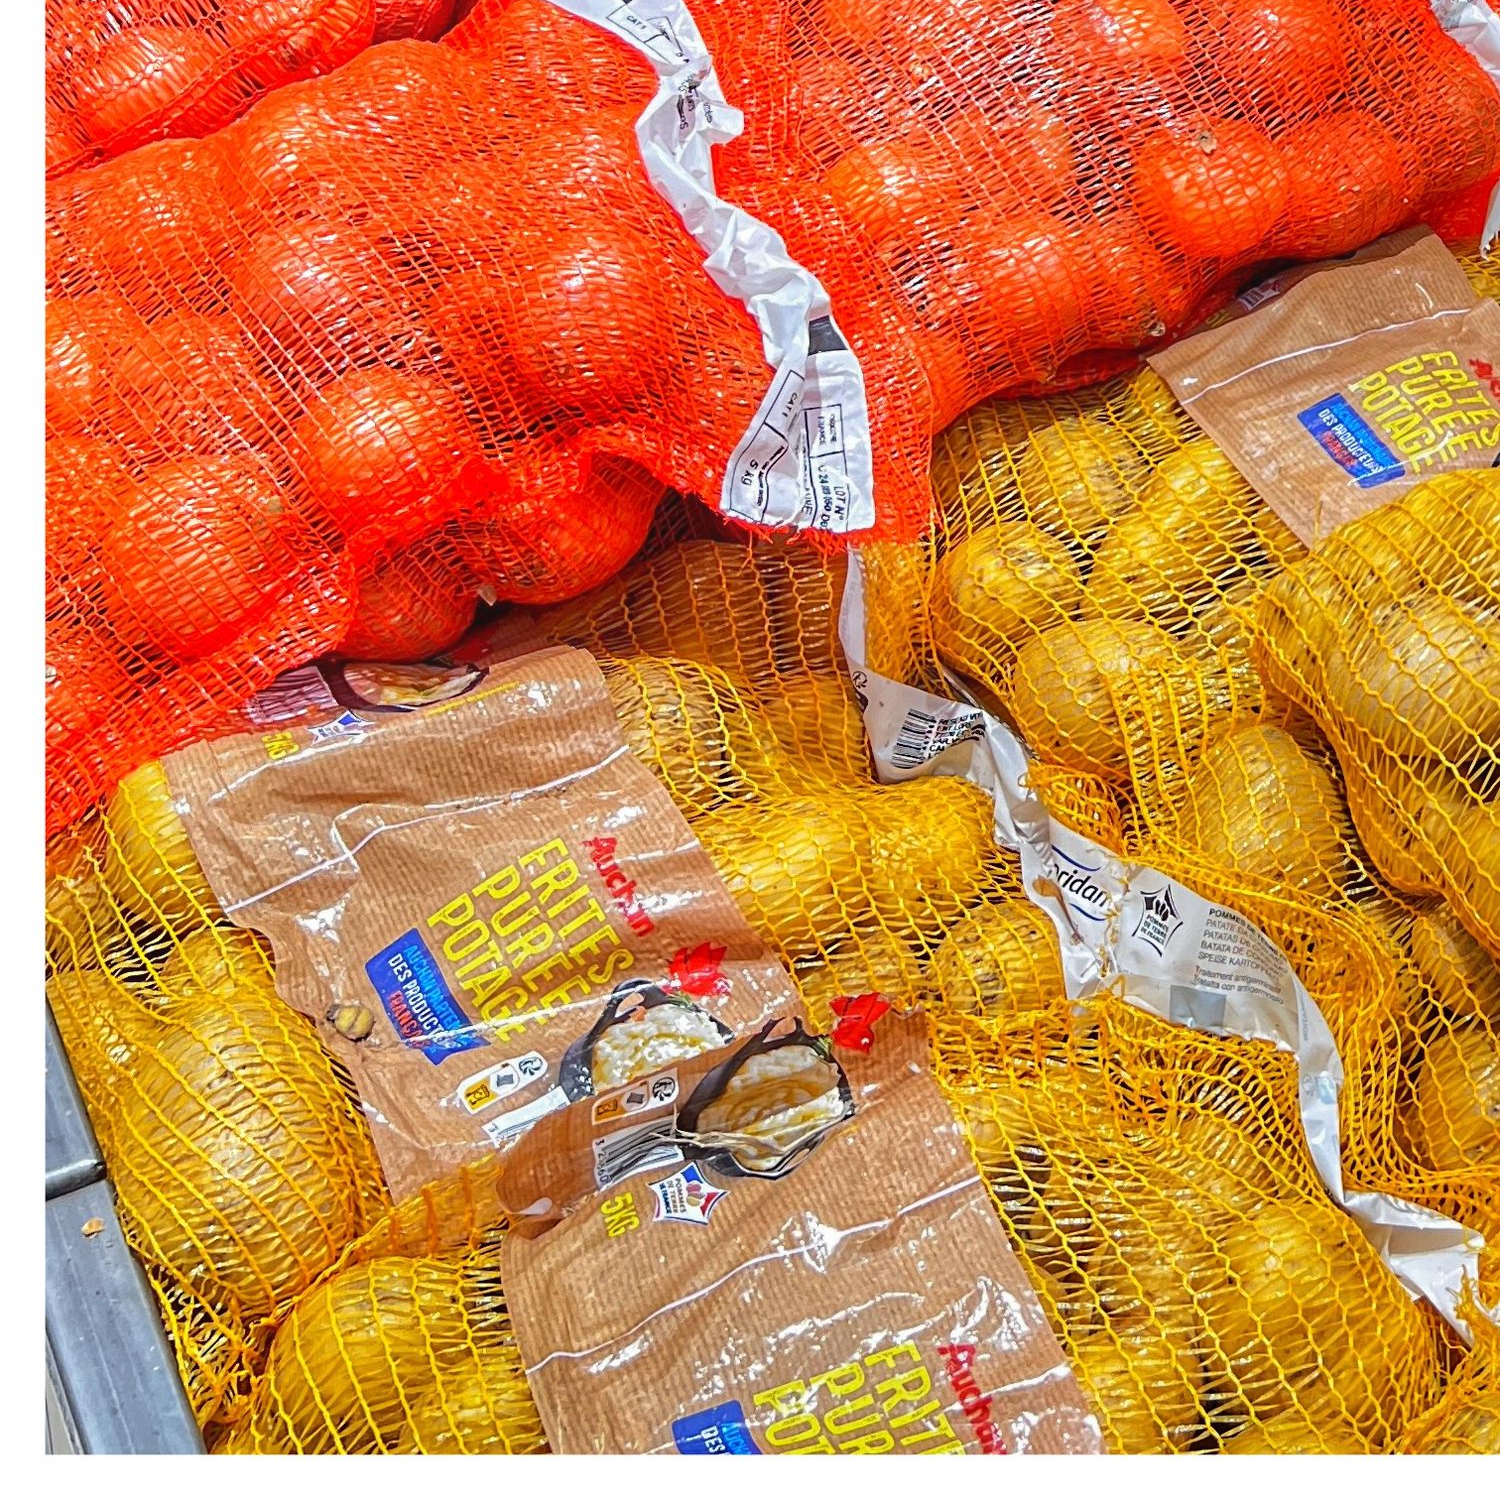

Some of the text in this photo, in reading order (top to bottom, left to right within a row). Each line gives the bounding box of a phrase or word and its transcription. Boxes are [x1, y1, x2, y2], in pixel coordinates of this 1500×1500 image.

[1351, 371, 1437, 473] POTAGE
[521, 836, 635, 989] FRITES
[582, 835, 656, 940] Auchan
[1053, 862, 1112, 908] ridan
[387, 953, 413, 983] DES
[425, 892, 533, 1045] POTAGE
[1200, 940, 1232, 953] BATATA
[600, 1191, 640, 1237] 5KG
